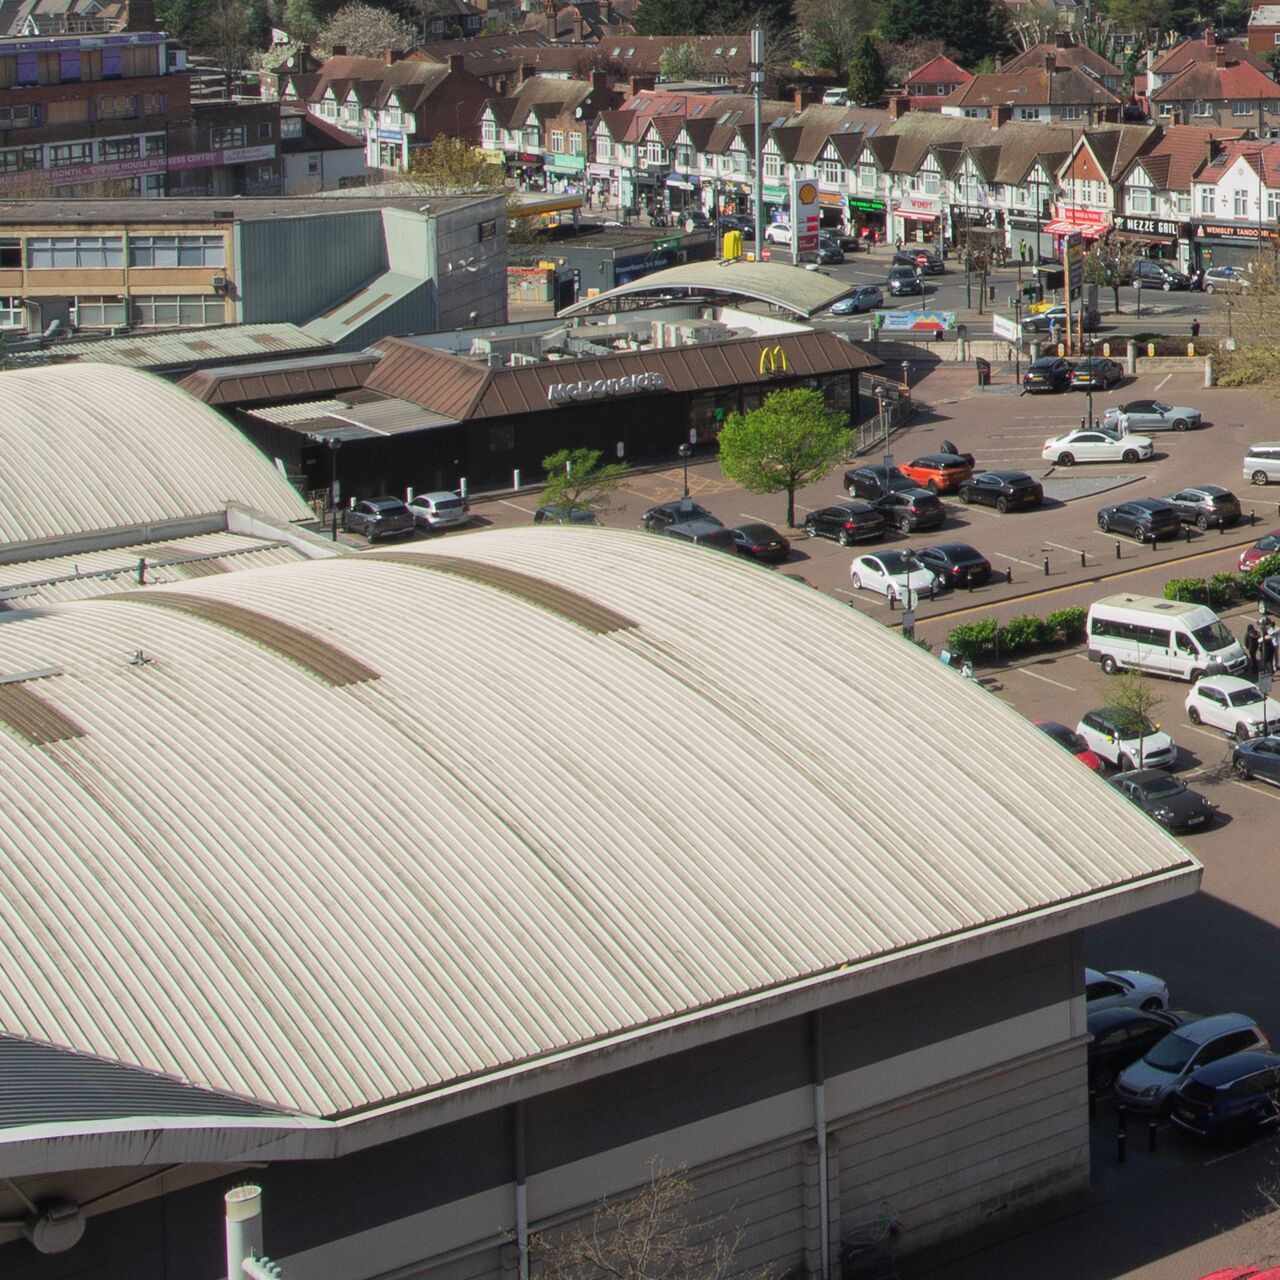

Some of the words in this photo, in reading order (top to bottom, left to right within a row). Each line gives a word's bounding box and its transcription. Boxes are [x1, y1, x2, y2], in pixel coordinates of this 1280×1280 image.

[911, 200, 934, 208] WIMPY
[1126, 219, 1154, 232] MEZZE
[1207, 227, 1233, 236] WEMBLEY
